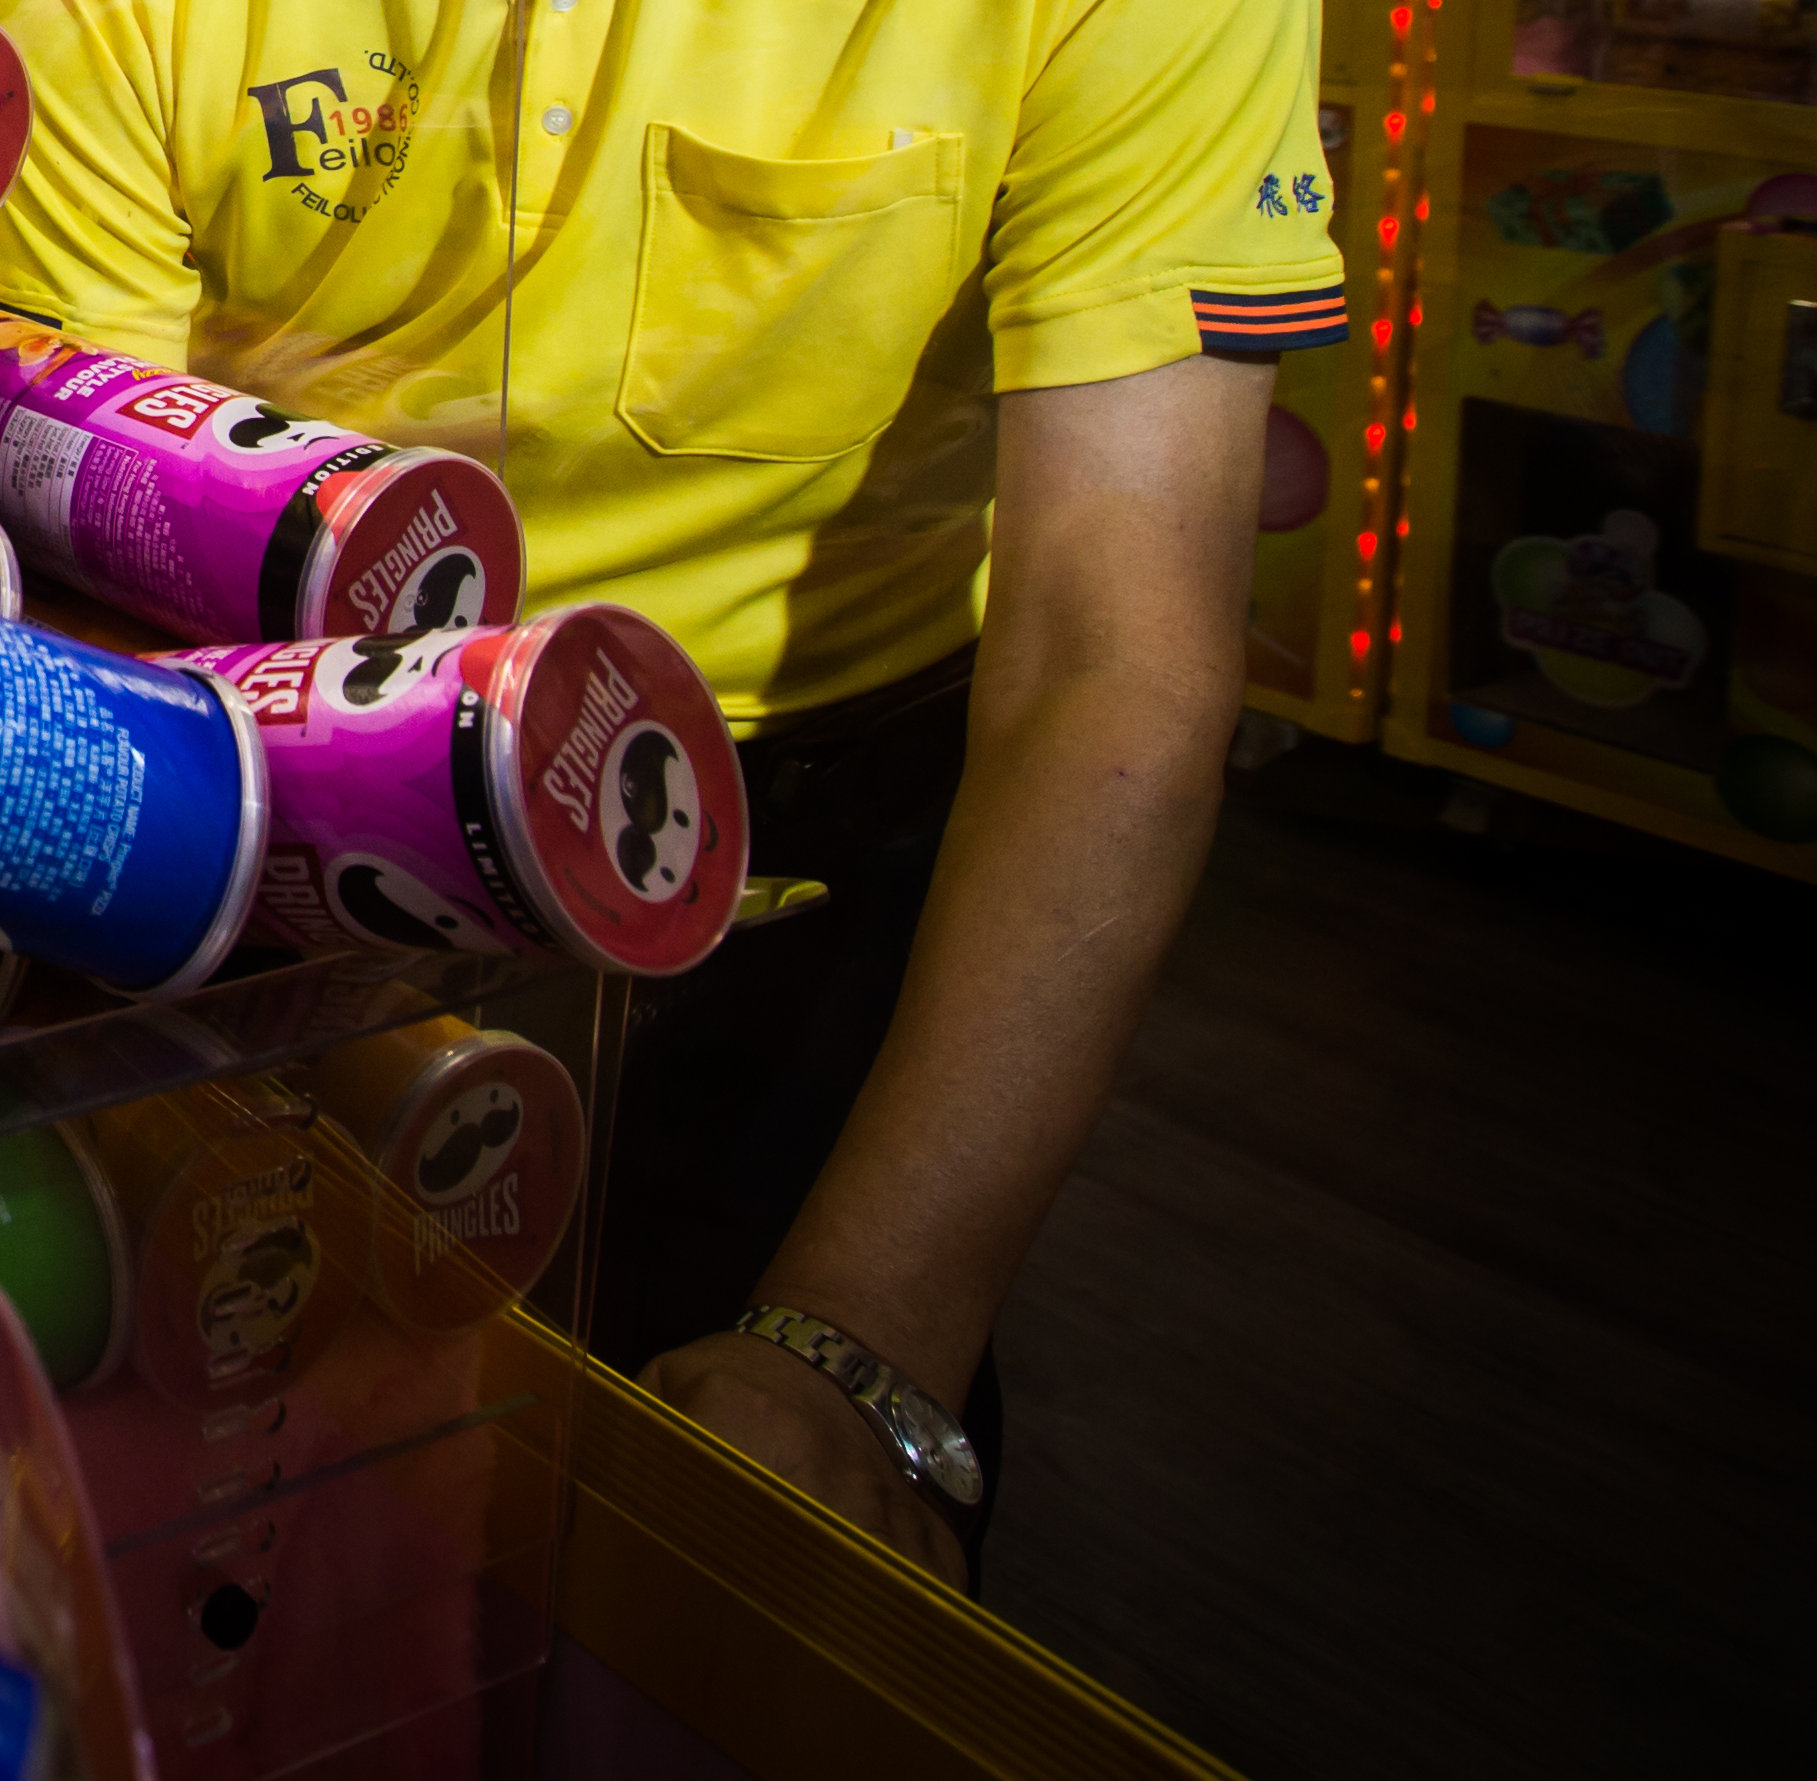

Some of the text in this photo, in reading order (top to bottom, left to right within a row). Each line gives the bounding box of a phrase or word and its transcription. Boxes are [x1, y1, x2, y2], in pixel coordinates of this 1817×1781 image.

[329, 103, 409, 137] 1986
[134, 381, 231, 429] GLES
[111, 455, 131, 492] Nutrition
[302, 443, 385, 497] EDITION
[347, 487, 459, 632] PRINGLES
[542, 647, 641, 835] PRINGLES
[97, 726, 129, 862] FLAVOUR POTATO CRISPS
[412, 1172, 520, 1277] PRINGLES
